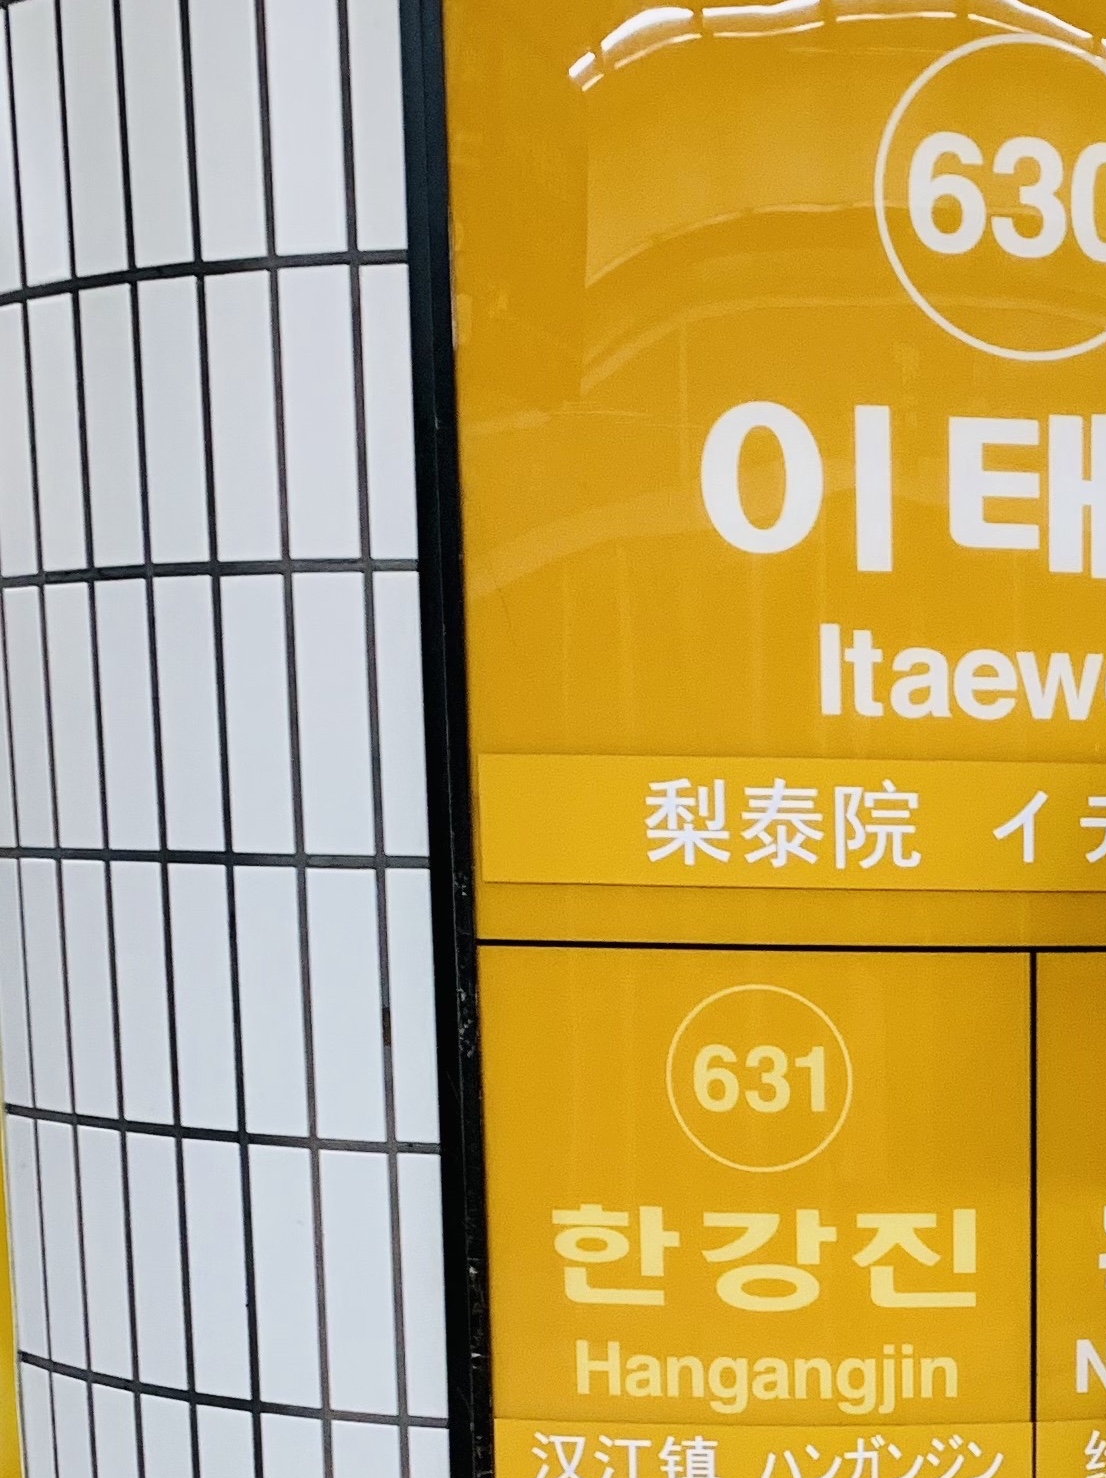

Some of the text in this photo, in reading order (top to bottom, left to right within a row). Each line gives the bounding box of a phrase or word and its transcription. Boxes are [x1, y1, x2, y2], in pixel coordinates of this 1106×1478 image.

[644, 777, 922, 870] 梨泰院
[692, 1044, 828, 1114] 631
[551, 1204, 978, 1313] 한강진
[574, 1339, 959, 1415] Hangangjin
